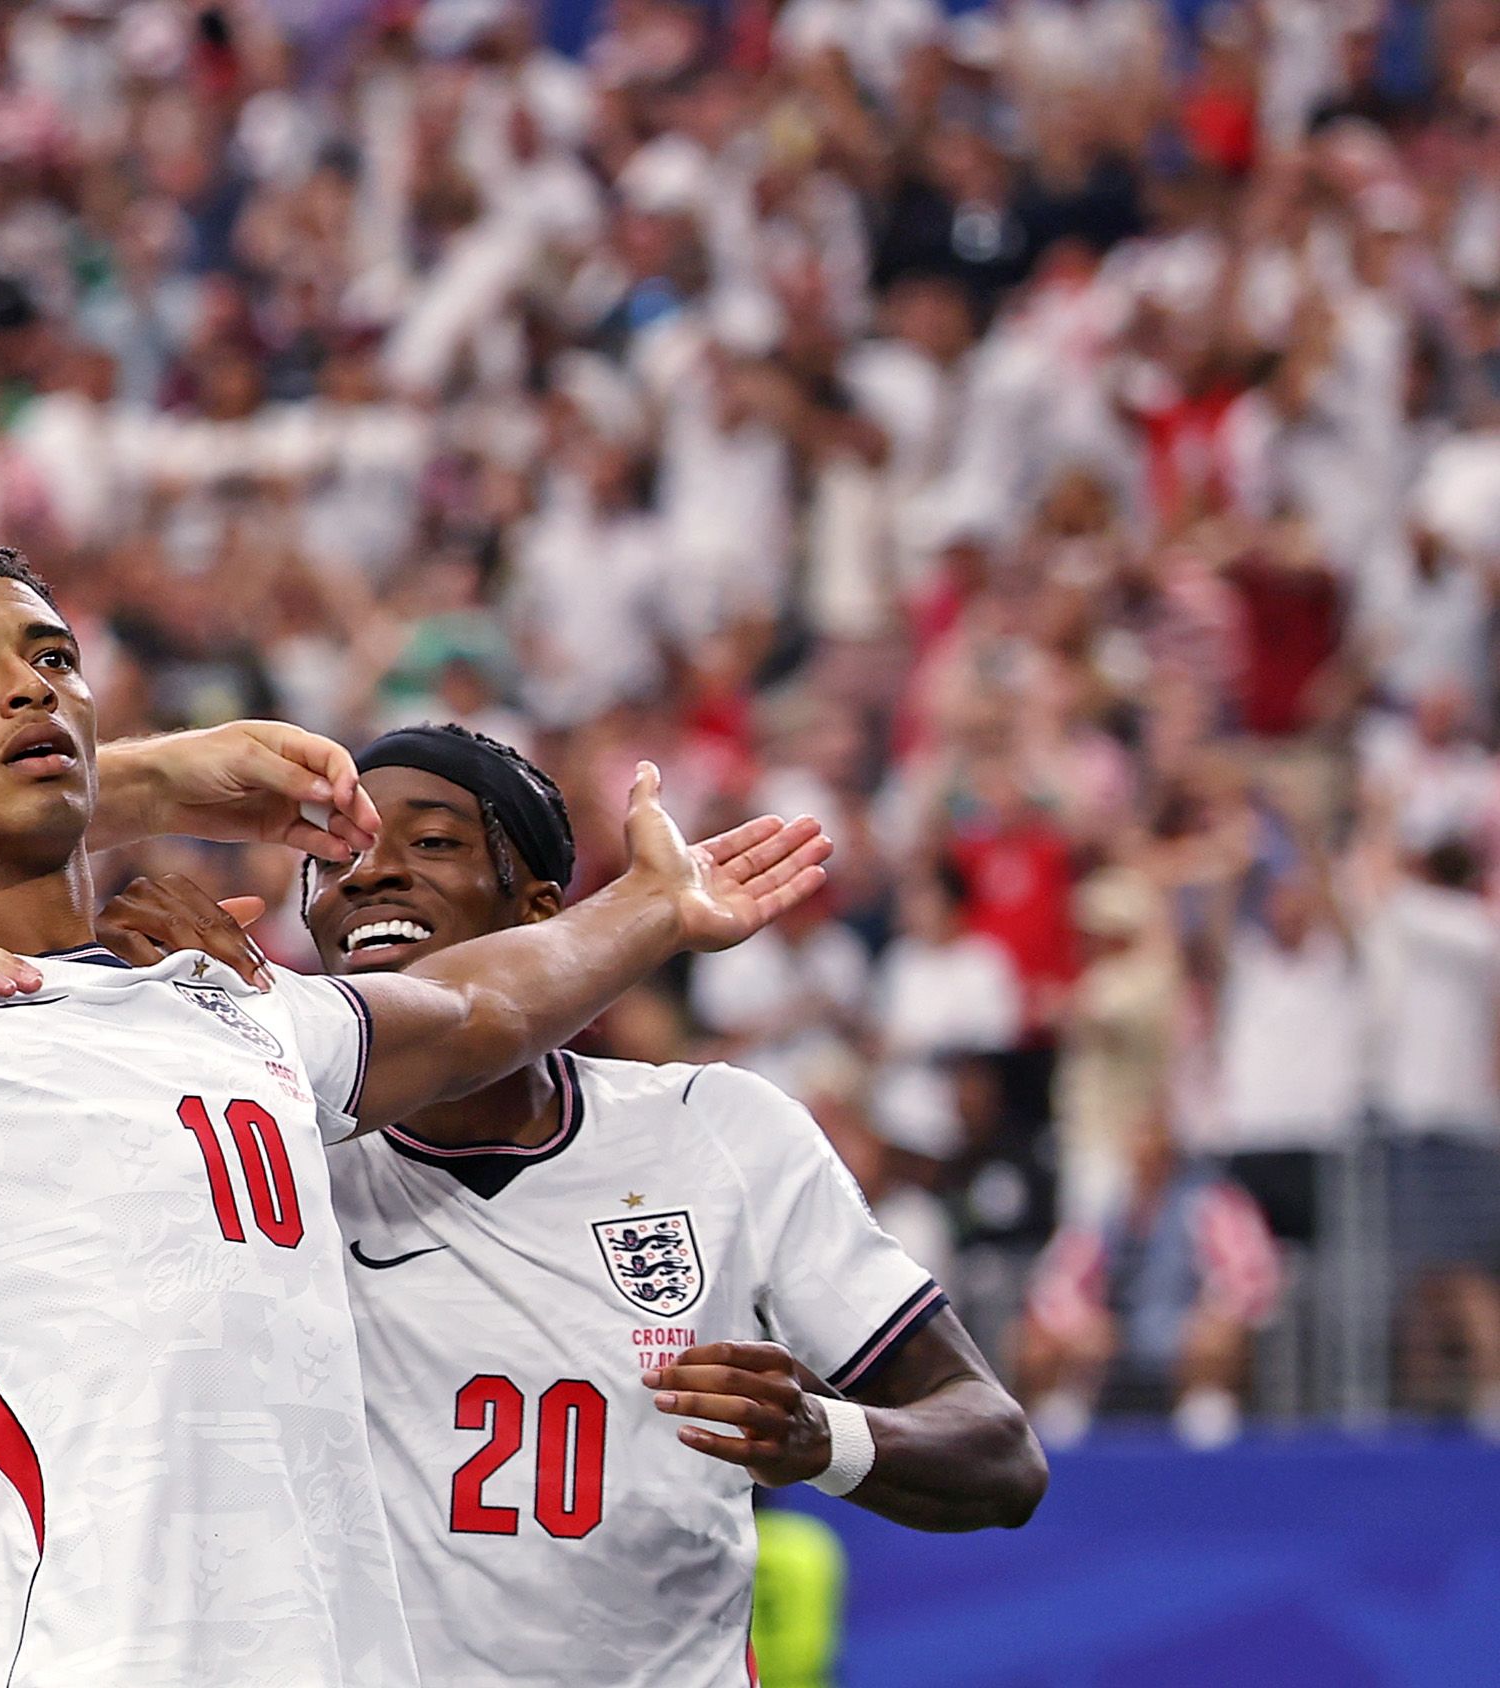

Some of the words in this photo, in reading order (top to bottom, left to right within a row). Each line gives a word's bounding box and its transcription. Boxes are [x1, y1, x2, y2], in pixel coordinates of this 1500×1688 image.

[176, 1094, 304, 1249] 10
[632, 1327, 696, 1347] CROATIA
[450, 1374, 607, 1539] 20
